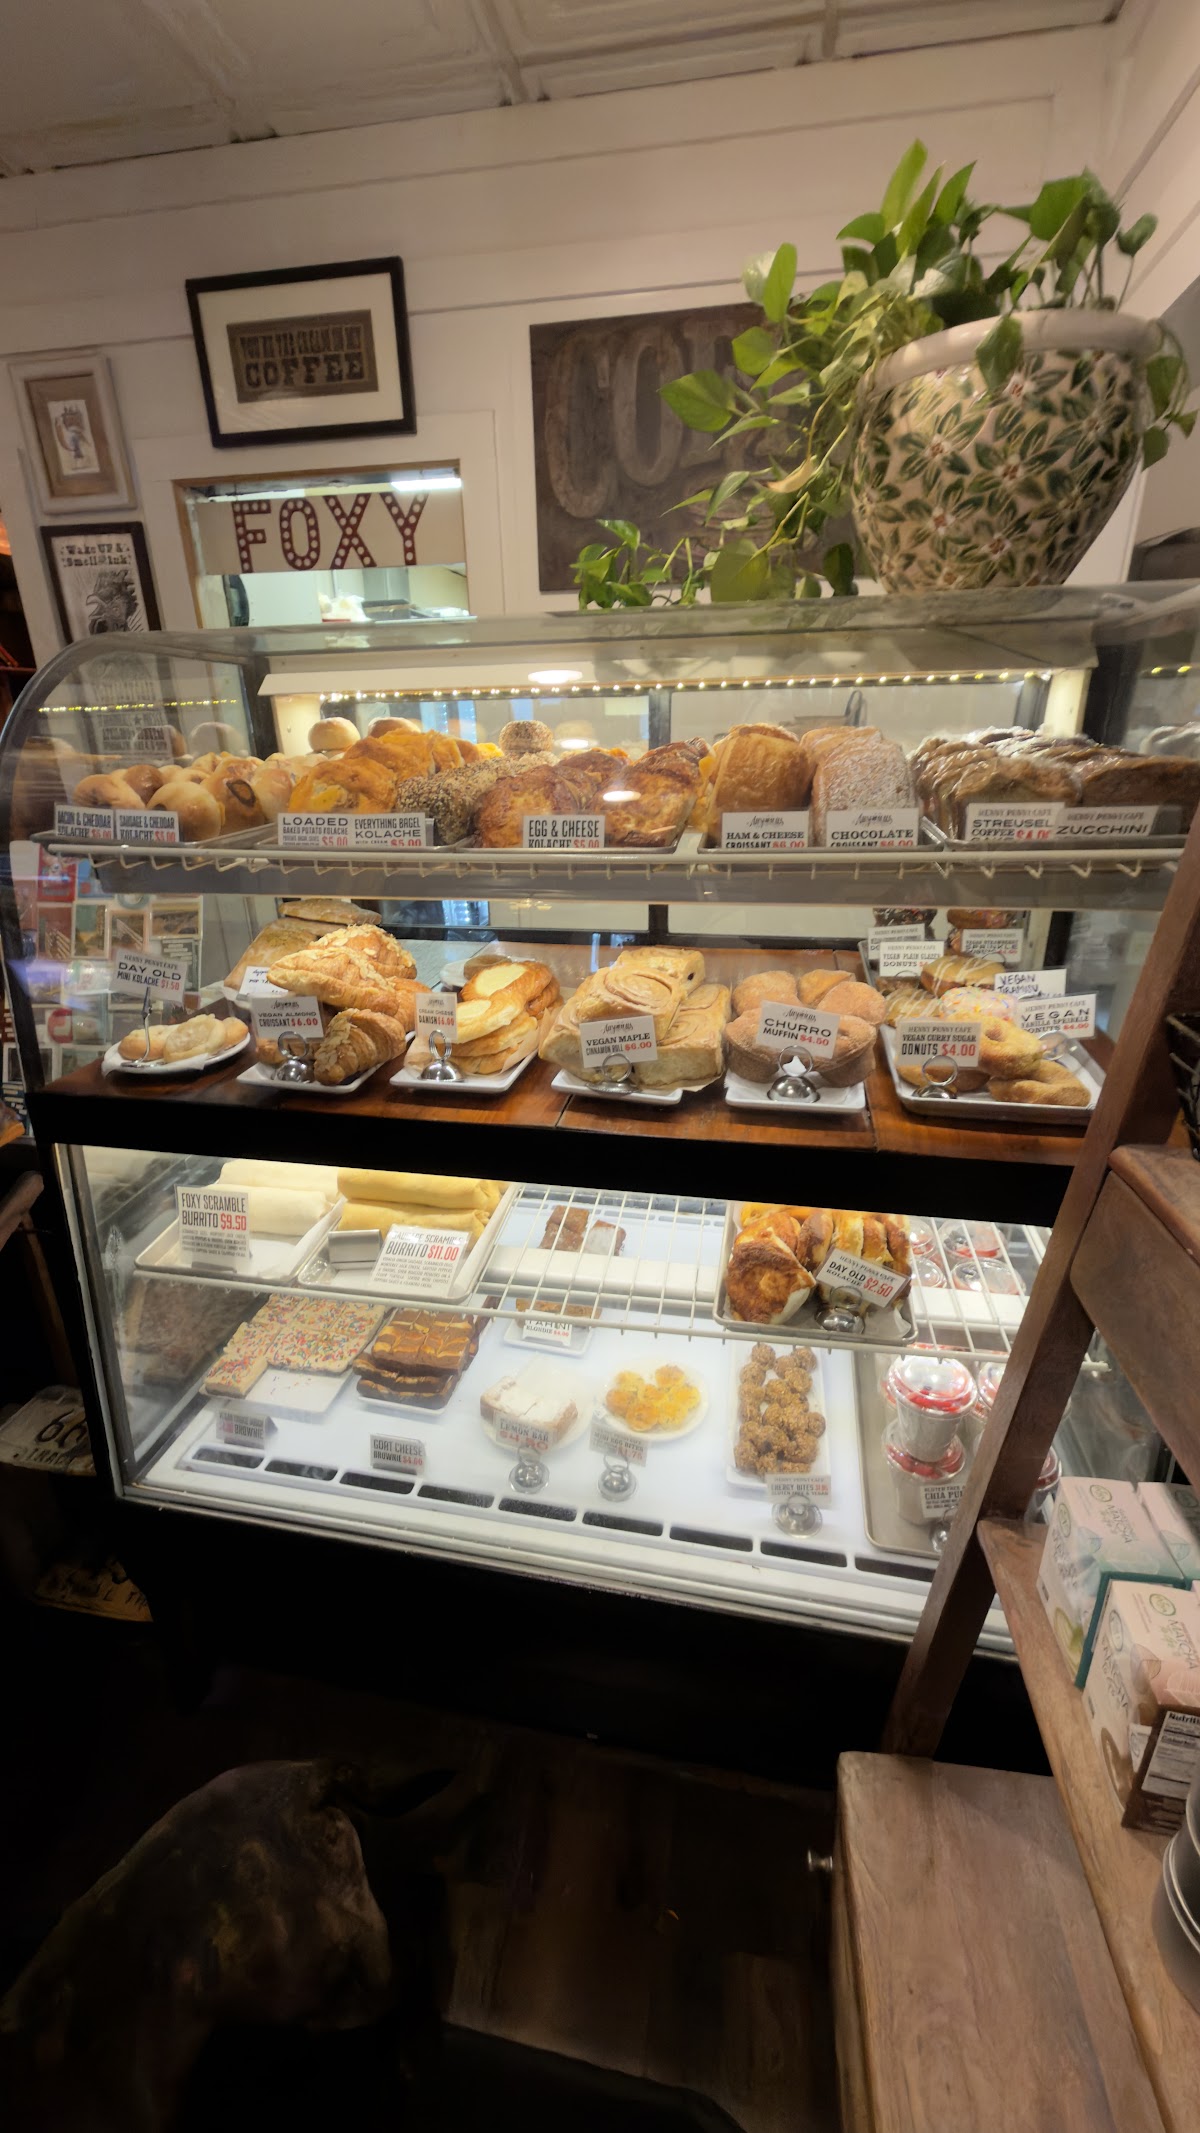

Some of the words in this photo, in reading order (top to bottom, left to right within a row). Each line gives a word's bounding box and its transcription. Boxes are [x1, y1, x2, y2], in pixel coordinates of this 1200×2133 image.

[245, 352, 364, 388] COFFEE
[232, 493, 429, 574] FOXY
[65, 545, 96, 555] Wake
[66, 555, 98, 567] Smell
[82, 813, 111, 829] CHEDDAR
[149, 816, 175, 829] CHEDDAR
[282, 816, 349, 827] LOADED
[354, 818, 397, 830] EVERYTHING
[399, 816, 421, 829] BAGEL
[972, 819, 1055, 828] STREUSEL
[282, 826, 302, 835] BAKED
[302, 827, 323, 836] POTATO
[323, 827, 349, 836] KOLACHE
[355, 829, 422, 839] KOLACHE
[528, 819, 548, 838] EGG
[550, 819, 559, 838] &
[561, 819, 600, 838] CHEESE
[830, 829, 915, 840] CHOCOLATE
[971, 828, 1015, 837] COFFEE
[1056, 824, 1148, 835] ZUCCHINI
[154, 831, 176, 843] $500
[322, 836, 348, 847] $500
[726, 831, 751, 840] HAM
[752, 832, 760, 840] &
[761, 831, 805, 840] CHEESE
[390, 838, 422, 847] $500
[528, 838, 572, 848] KOLACHE
[573, 838, 600, 848] $500
[725, 840, 771, 849] CROISSANT
[772, 840, 805, 849] $600
[879, 839, 914, 847] $600
[118, 961, 147, 974] DAY
[152, 968, 182, 981] OLD
[117, 970, 131, 981] MINI
[132, 974, 159, 987] KOLACHE
[1000, 973, 1036, 985] VEGAN
[418, 1014, 437, 1025] DANISH
[1021, 1008, 1090, 1021] VEGAN
[258, 1018, 290, 1028] CROISSANT
[290, 1016, 319, 1027] $6.00
[764, 1018, 832, 1038] CHURRO
[1023, 1026, 1060, 1034] ONUTS
[586, 1035, 618, 1046] VEGAN
[618, 1032, 650, 1043] MAPLE
[762, 1027, 799, 1040] MUFFIN
[799, 1033, 830, 1046] $4.50
[902, 1034, 926, 1042] VEGAN
[927, 1034, 951, 1042] CURRY
[952, 1034, 977, 1042] SUGAR
[585, 1044, 612, 1056] CINNAMON
[611, 1043, 624, 1053] ROLL
[624, 1041, 652, 1052] $6.00
[901, 1043, 938, 1056] DONUTS
[942, 1042, 976, 1057] $4.00
[181, 1192, 201, 1209] FOXY
[203, 1194, 246, 1213] SCRAMBLE
[182, 1210, 219, 1229] BURRITO
[220, 1212, 247, 1231] $9.50
[392, 1231, 424, 1243] SAUAGE
[425, 1234, 464, 1246] SCRAMBE
[385, 1240, 429, 1258] BURRITO
[427, 1244, 460, 1262] $11.00
[839, 1255, 859, 1269] HENNY
[826, 1268, 863, 1286] KOLACHE
[829, 1260, 847, 1274] DAY
[848, 1269, 867, 1282] OLD
[863, 1277, 894, 1298] $2.50
[526, 1325, 553, 1335] BLONDIE
[234, 1423, 264, 1440] BROWNIE
[500, 1421, 530, 1437] LEMON
[531, 1430, 549, 1442] BAR
[373, 1439, 392, 1452] GOAT
[394, 1442, 423, 1457] CHEESE
[624, 1441, 644, 1452] BITES
[373, 1450, 402, 1463] BROWNIE
[796, 1483, 814, 1491] BITES
[924, 1491, 946, 1500] CHIA
